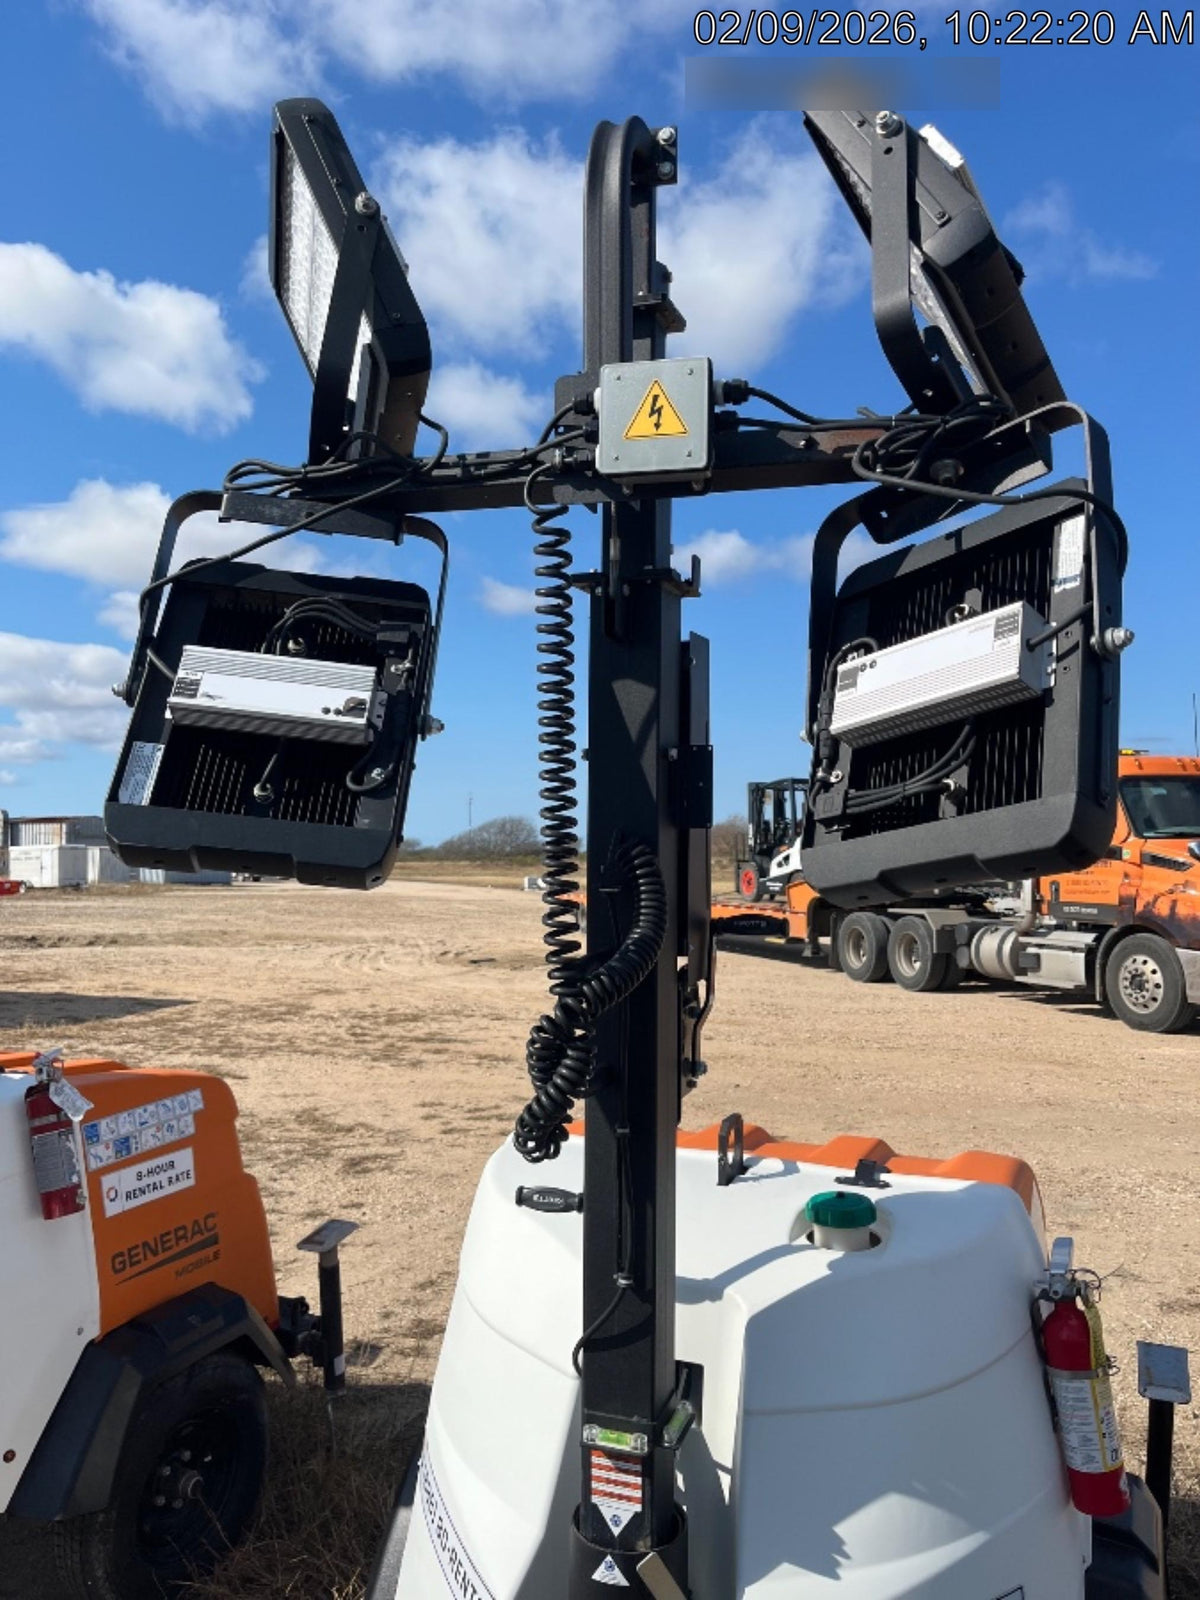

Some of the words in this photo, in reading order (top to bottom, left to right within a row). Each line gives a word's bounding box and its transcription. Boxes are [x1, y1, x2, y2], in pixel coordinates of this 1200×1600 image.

[126, 1180, 165, 1202] RENTAL
[167, 1169, 192, 1187] RATE
[136, 1161, 175, 1181] 8-HOUR
[110, 1212, 217, 1275] GENERAC
[174, 1249, 220, 1277] MOBILE
